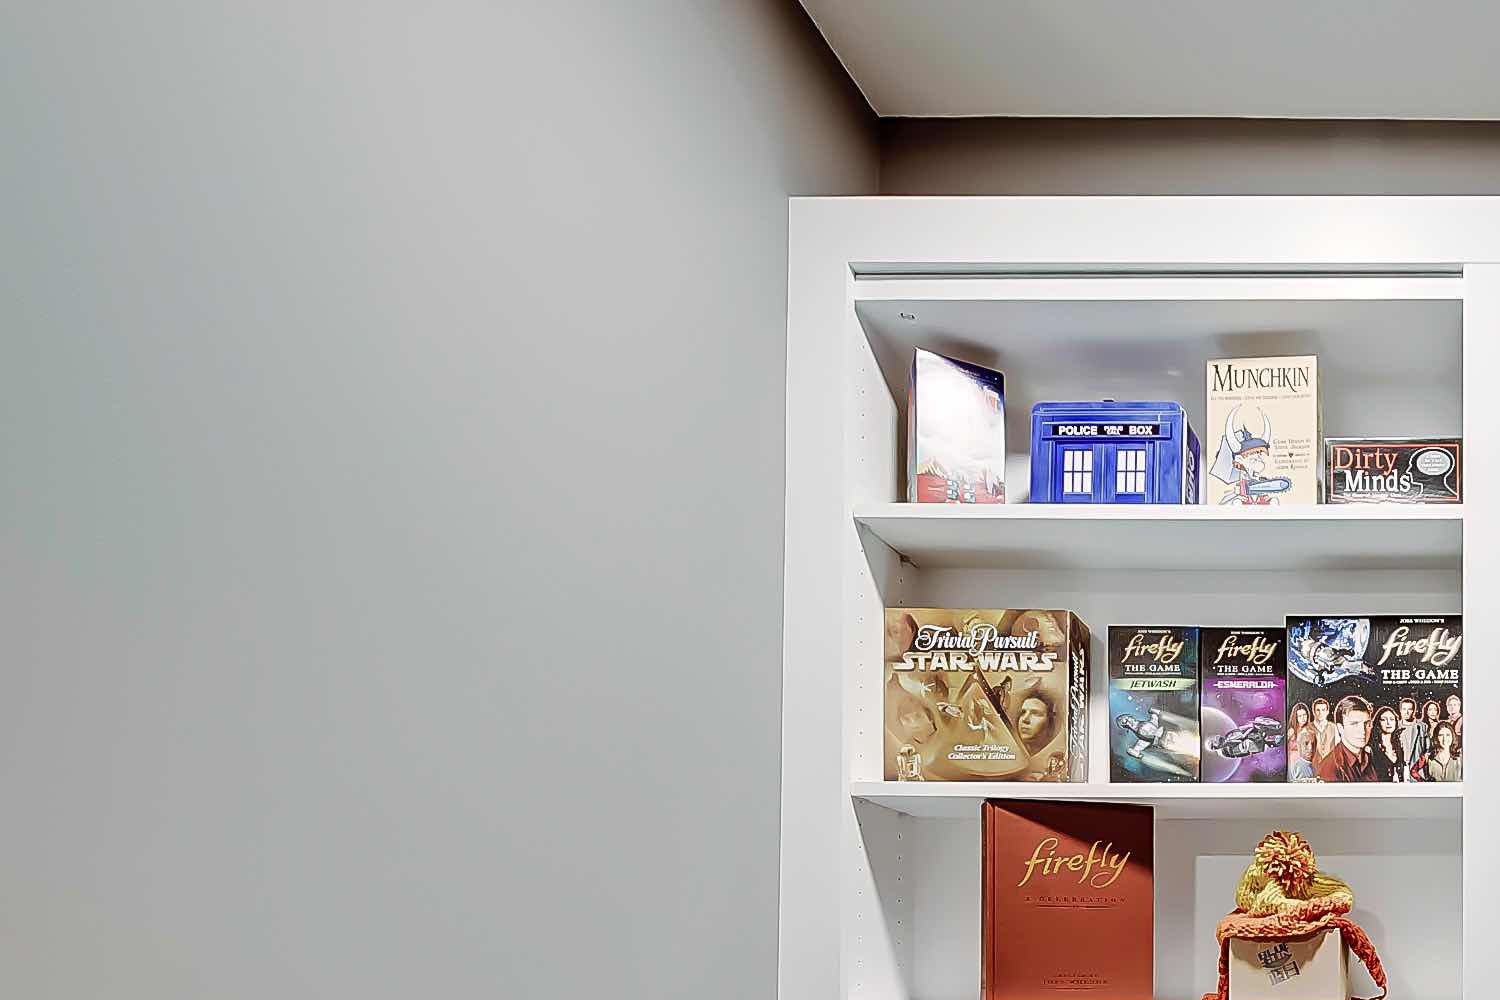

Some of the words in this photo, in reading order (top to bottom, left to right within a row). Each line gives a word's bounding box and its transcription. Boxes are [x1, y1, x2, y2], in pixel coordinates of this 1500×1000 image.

[1212, 364, 1310, 392] MUNCHKIN
[1058, 426, 1098, 435] POLICE
[1129, 426, 1152, 435] BOX
[1335, 448, 1396, 476] Dirty
[1344, 469, 1410, 492] Minds
[915, 625, 977, 651] Trivial
[969, 623, 1039, 656] Pursuit
[1121, 635, 1184, 663] firefly
[1214, 636, 1278, 664] firefly
[1377, 626, 1462, 666] firefly
[894, 652, 975, 671] STAR
[977, 652, 1057, 671] WARS
[1381, 670, 1410, 679] THE
[1415, 670, 1458, 679] GAME
[1130, 680, 1177, 688] JETWASH
[1018, 837, 1131, 888] firefly
